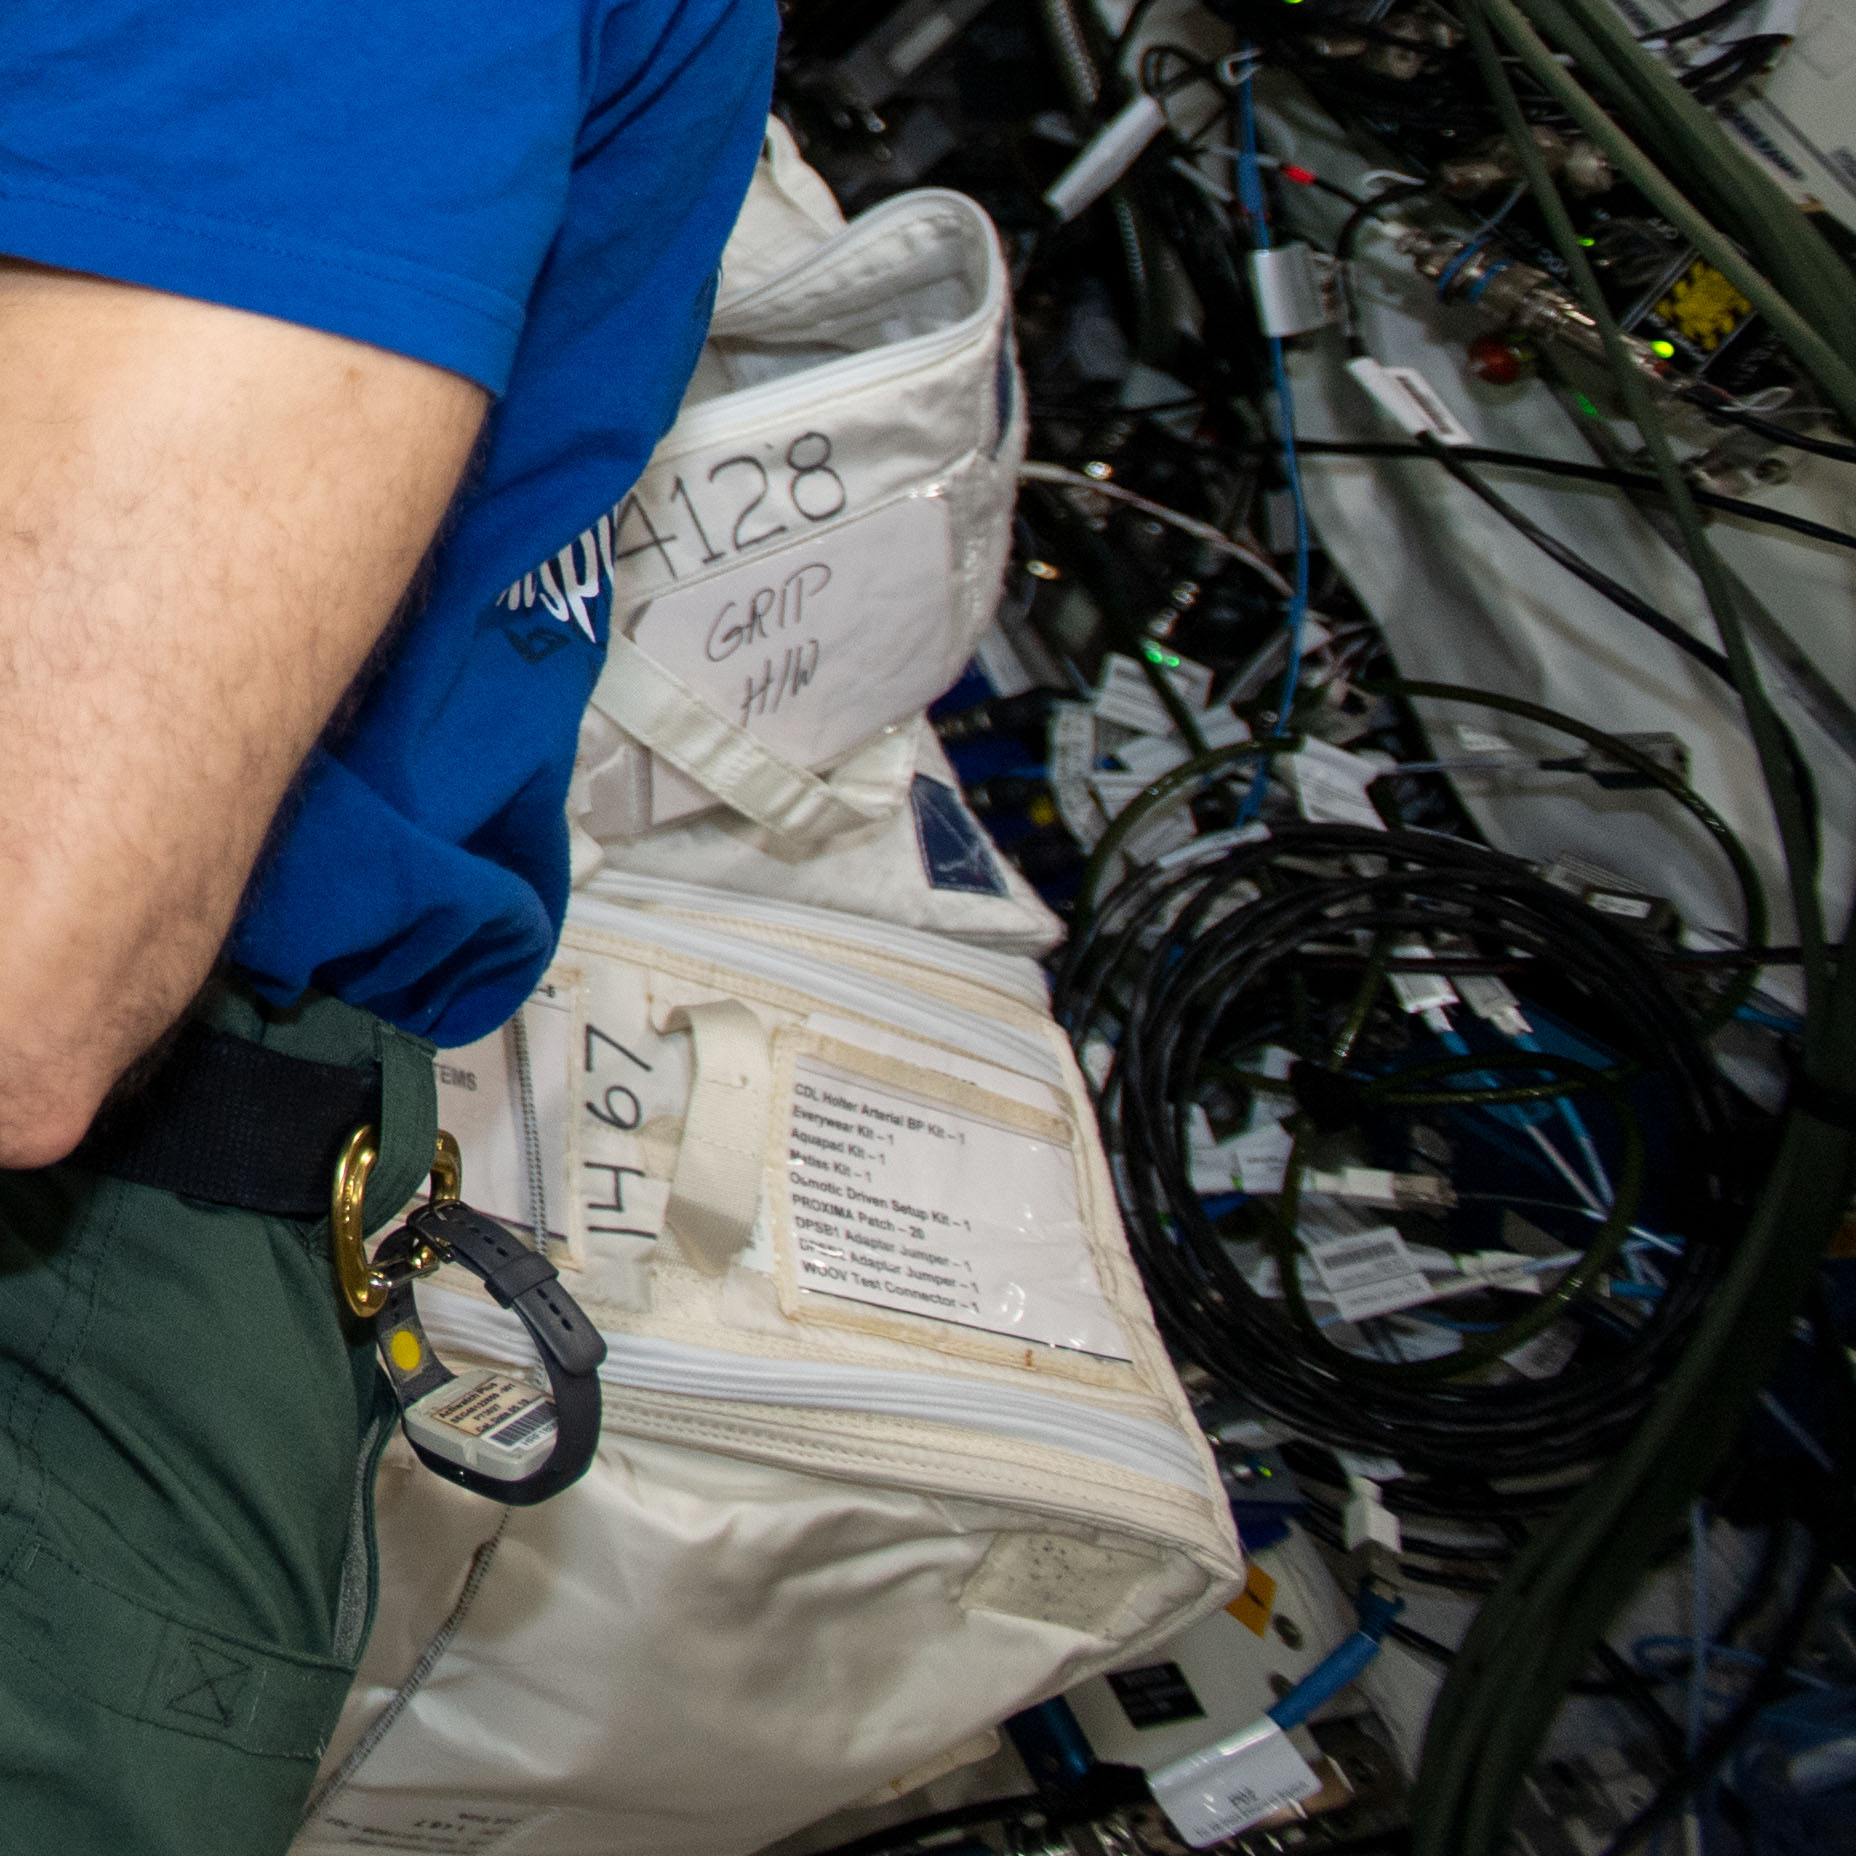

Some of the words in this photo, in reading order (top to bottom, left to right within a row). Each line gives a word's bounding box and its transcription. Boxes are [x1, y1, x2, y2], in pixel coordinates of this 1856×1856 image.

[614, 429, 849, 580] 4128
[703, 557, 835, 666] GRIP
[738, 640, 823, 724] H/W
[857, 1124, 875, 1138] Kit
[929, 1123, 945, 1137] Kit
[849, 1144, 866, 1159] Kit
[834, 1162, 851, 1177] Kit
[793, 1195, 854, 1220] PROXIMA
[858, 1213, 895, 1232] Patch
[847, 1188, 888, 1208] Driven
[931, 1213, 949, 1228] Kit
[851, 1274, 882, 1290] Test
[885, 1282, 956, 1307] Connector
